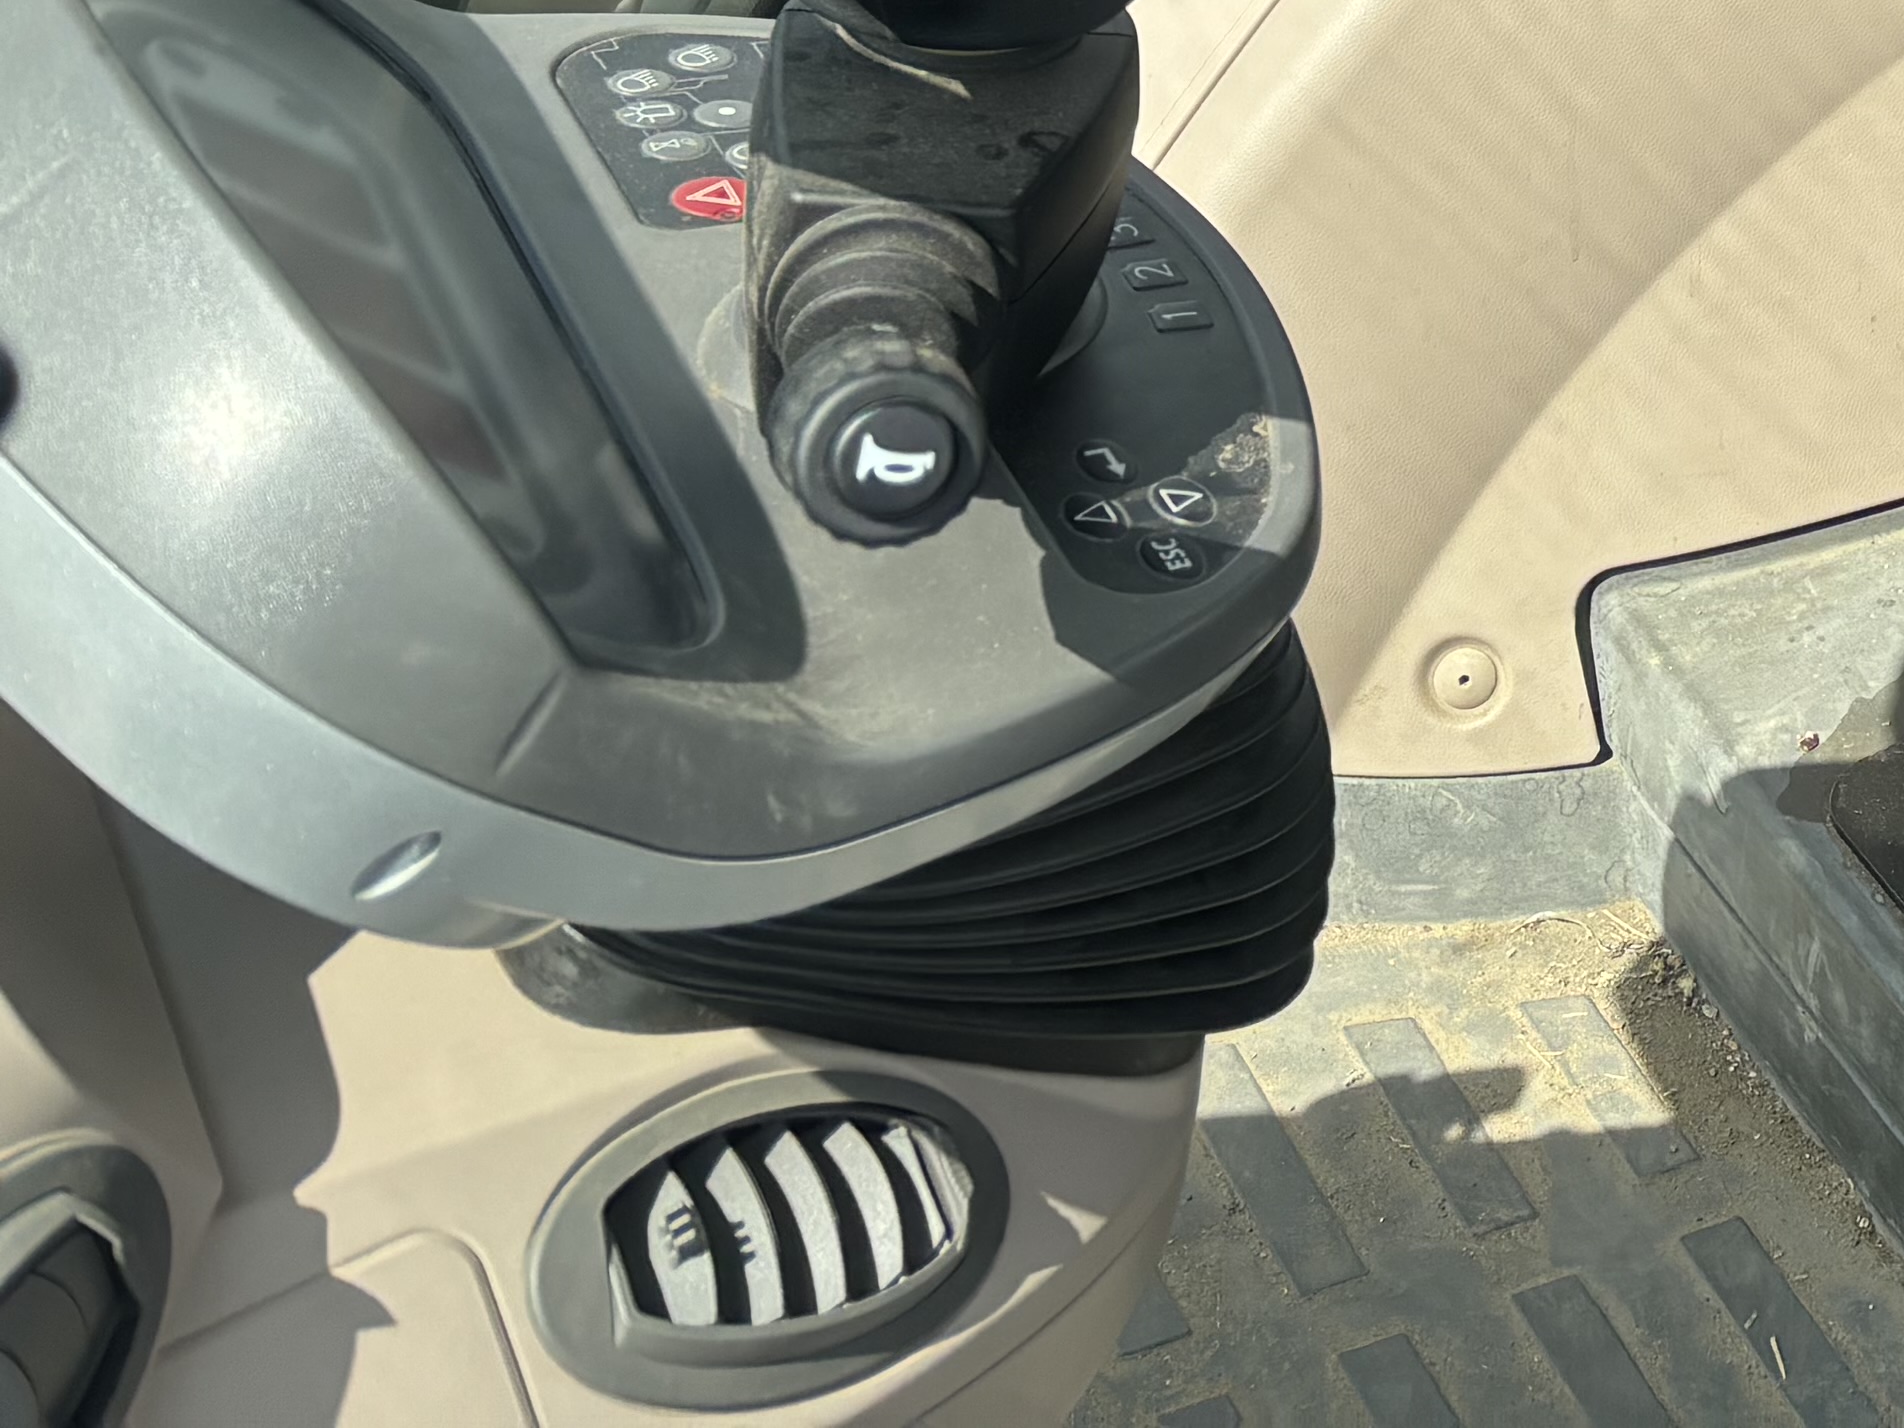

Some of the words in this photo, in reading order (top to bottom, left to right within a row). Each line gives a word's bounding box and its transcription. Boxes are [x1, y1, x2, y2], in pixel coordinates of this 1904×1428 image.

[1134, 263, 1175, 280] 2
[1161, 311, 1198, 320] 1
[1150, 537, 1193, 571] ESC
